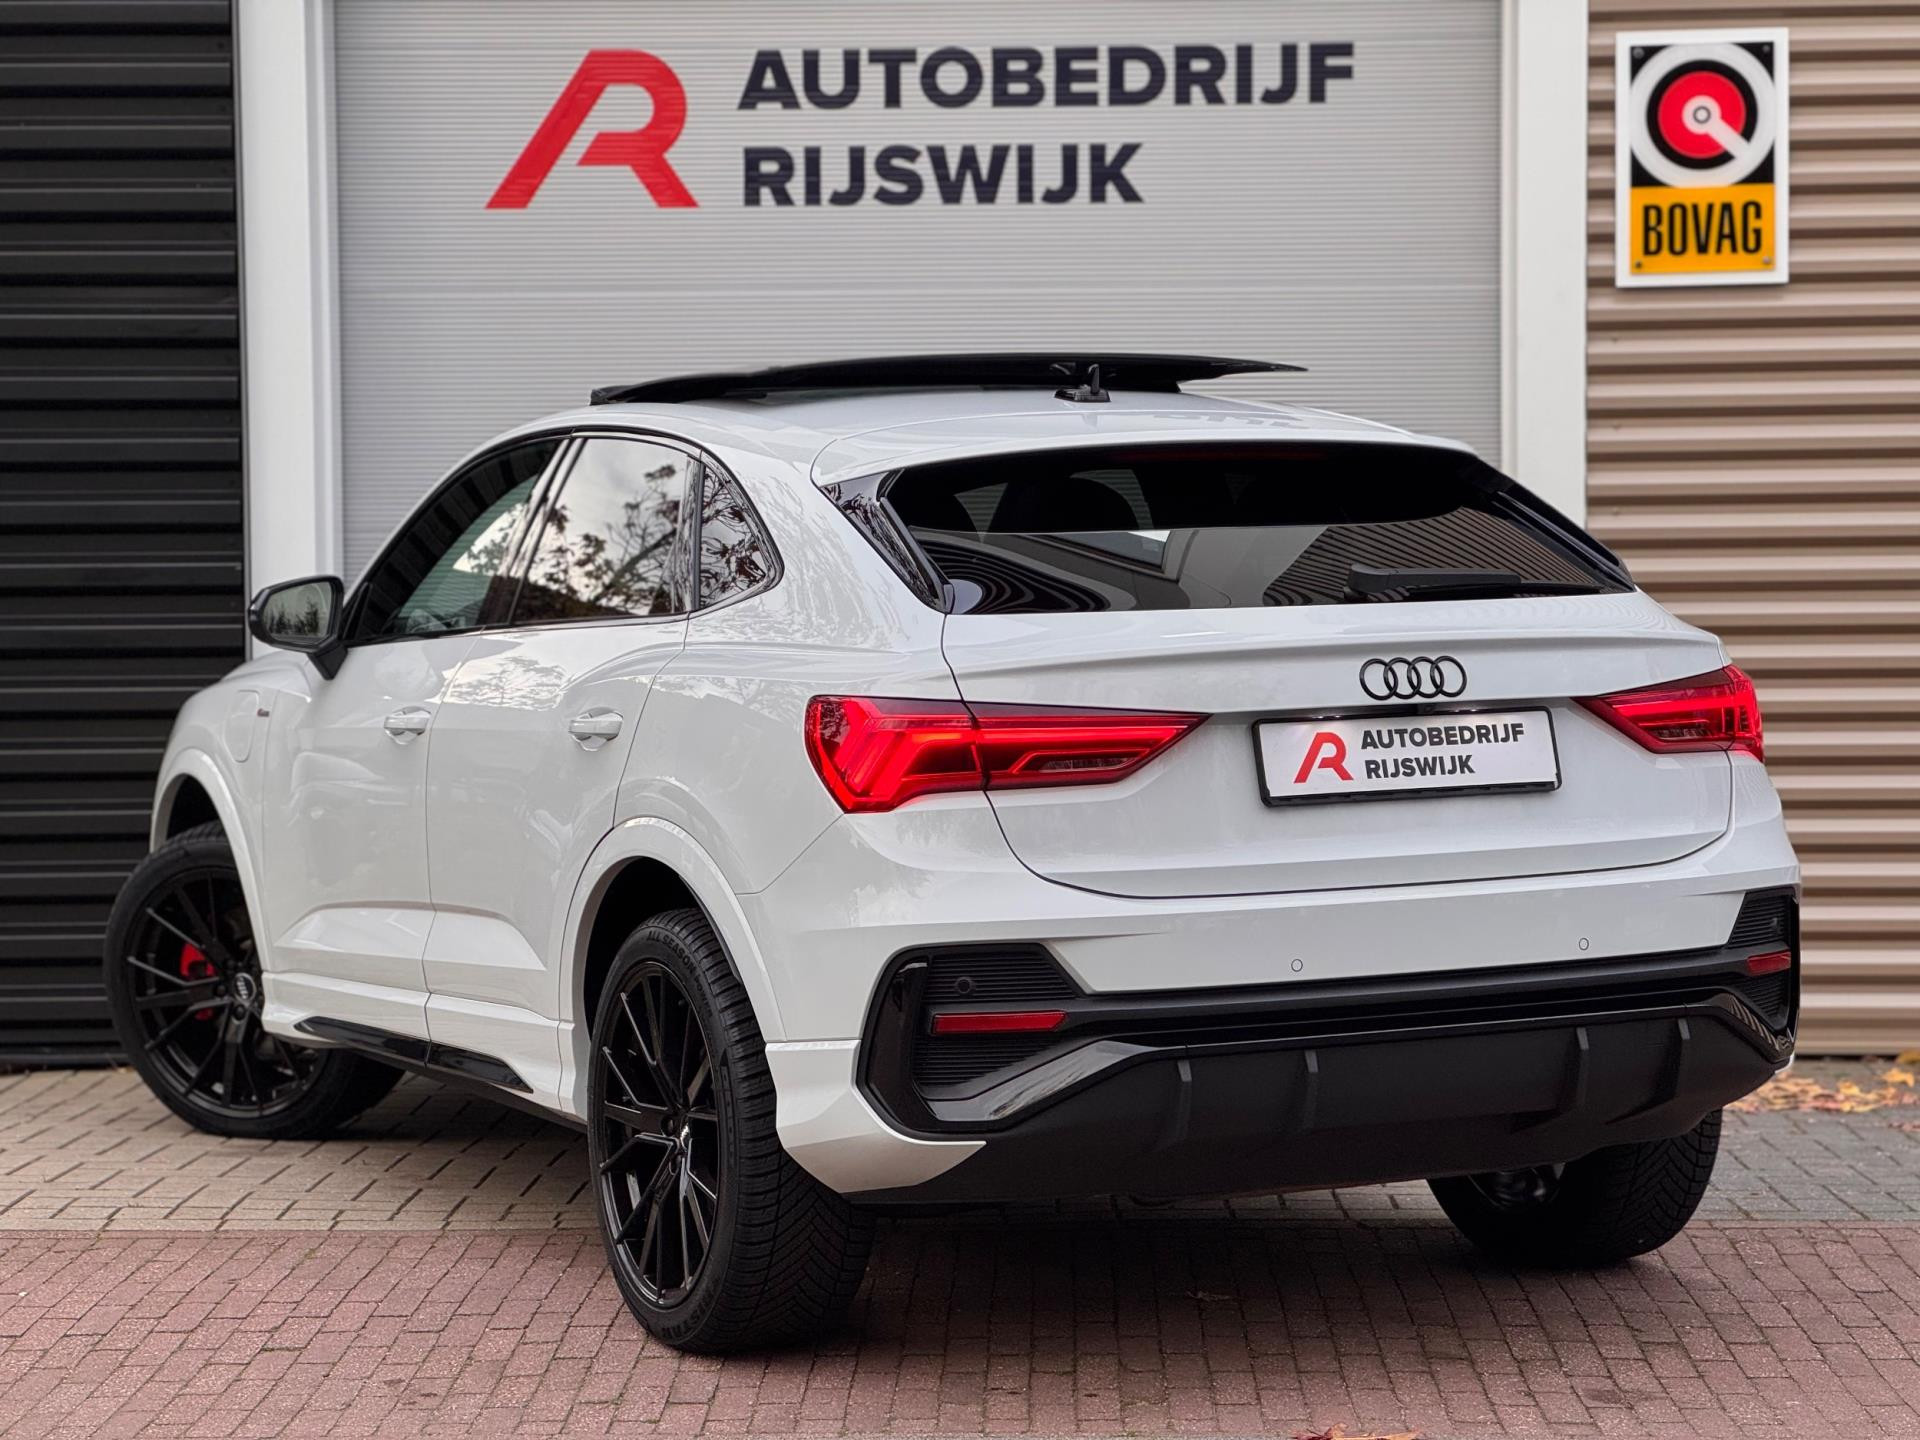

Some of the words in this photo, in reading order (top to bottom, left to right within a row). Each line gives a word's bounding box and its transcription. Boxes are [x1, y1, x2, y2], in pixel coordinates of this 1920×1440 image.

[738, 42, 1355, 110] AUTOBEDRIJF
[743, 142, 1144, 207] RIJSWIJK
[1642, 200, 1763, 256] BOVAG
[1361, 723, 1525, 750] AUTOBEDRIJF
[1365, 755, 1475, 780] RIJSWIJK
[661, 933, 697, 974] SEASON
